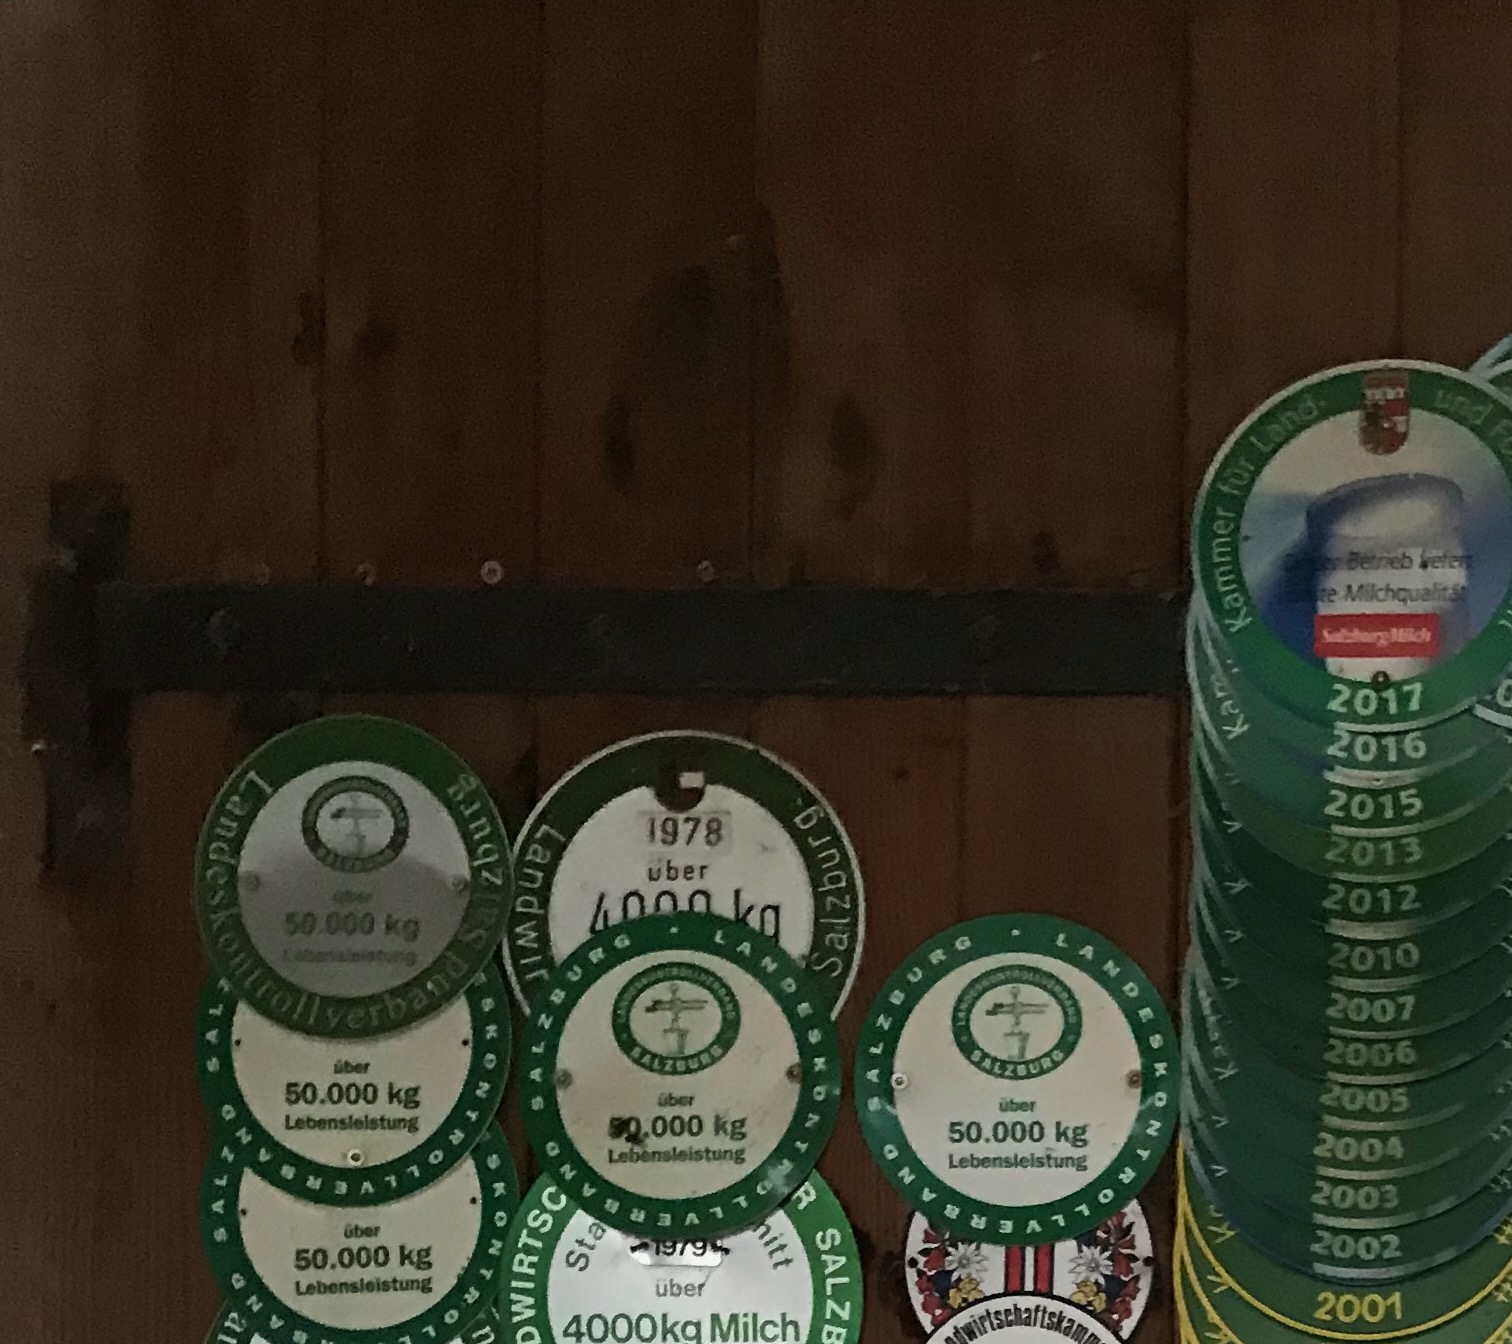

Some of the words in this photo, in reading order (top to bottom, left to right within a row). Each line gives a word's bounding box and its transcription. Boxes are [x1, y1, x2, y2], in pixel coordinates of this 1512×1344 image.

[1327, 682, 1422, 715] 2017
[1328, 732, 1425, 761] 2016
[1324, 789, 1422, 819] 2015
[650, 817, 721, 846] 1978
[1326, 837, 1421, 865] 2013
[648, 860, 708, 881] über
[1322, 884, 1420, 913] 2012
[1326, 993, 1415, 1022] 2007
[334, 1060, 370, 1074] über
[286, 1083, 378, 1104] 50.000
[388, 1082, 420, 1109] kg
[999, 1099, 1036, 1112] über
[285, 1115, 419, 1133] Lebensleistung
[949, 1121, 1044, 1143] 50.000
[1056, 1121, 1088, 1148] kg
[1313, 1132, 1403, 1161] 2004
[949, 1153, 1088, 1171] Lebensleistung
[1312, 1180, 1397, 1208] 2003
[1311, 1230, 1401, 1259] 2002
[1314, 1292, 1401, 1322] 2001
[711, 1312, 800, 1342] Milch
